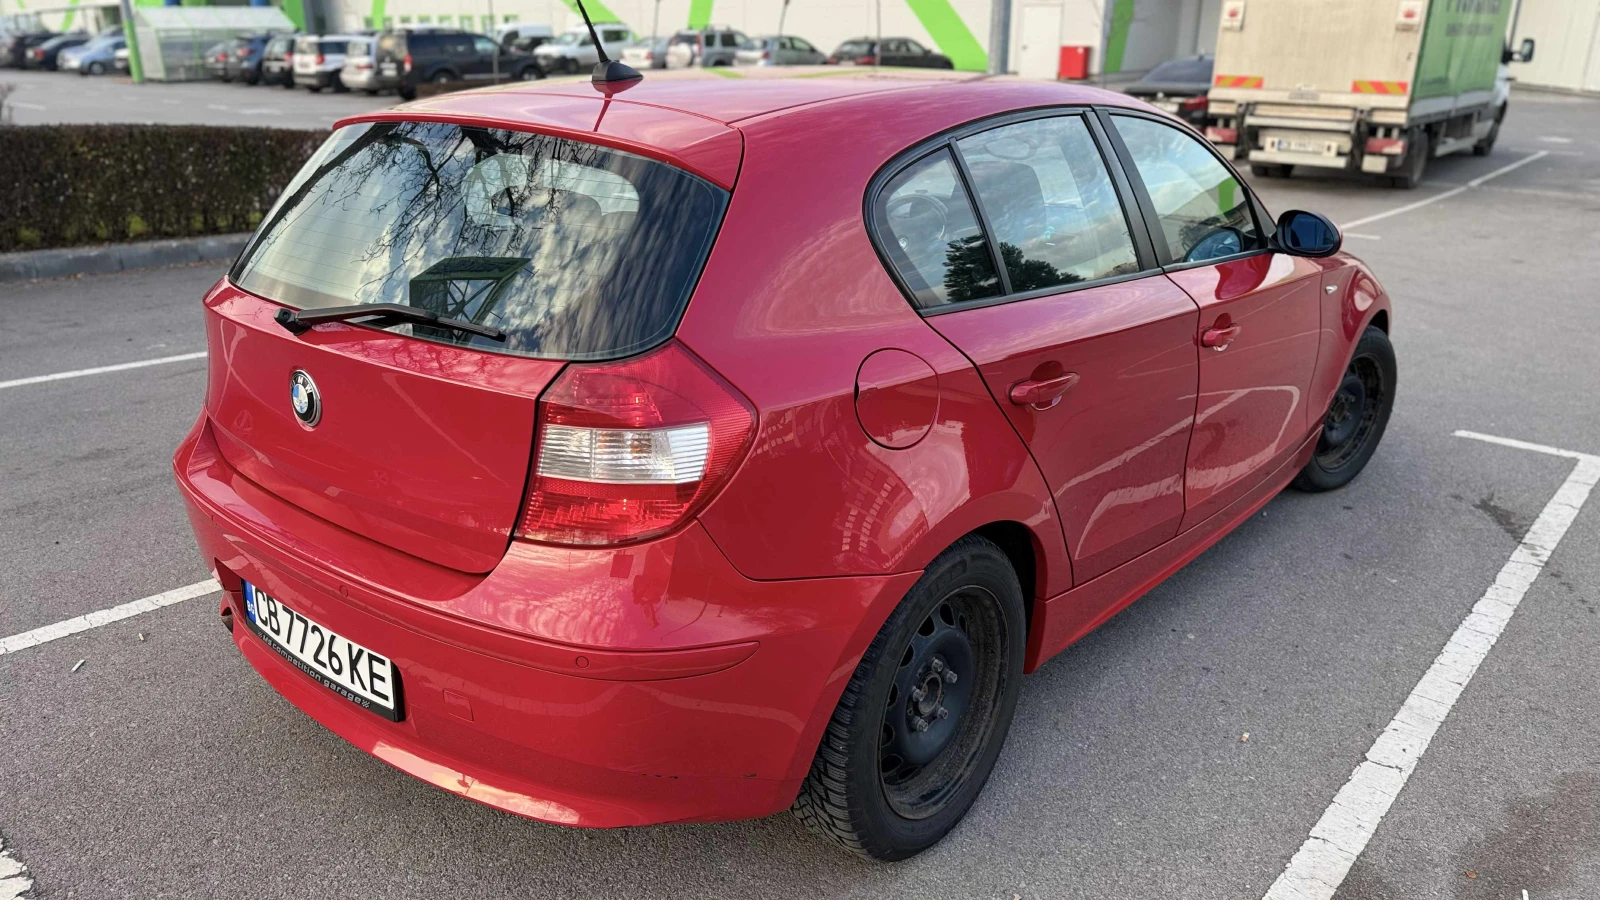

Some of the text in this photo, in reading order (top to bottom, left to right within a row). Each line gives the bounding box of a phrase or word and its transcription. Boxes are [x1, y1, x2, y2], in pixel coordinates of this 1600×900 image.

[246, 599, 255, 615] BG
[255, 587, 389, 702] CB 7726 KE
[262, 634, 362, 704] MS competition garage
